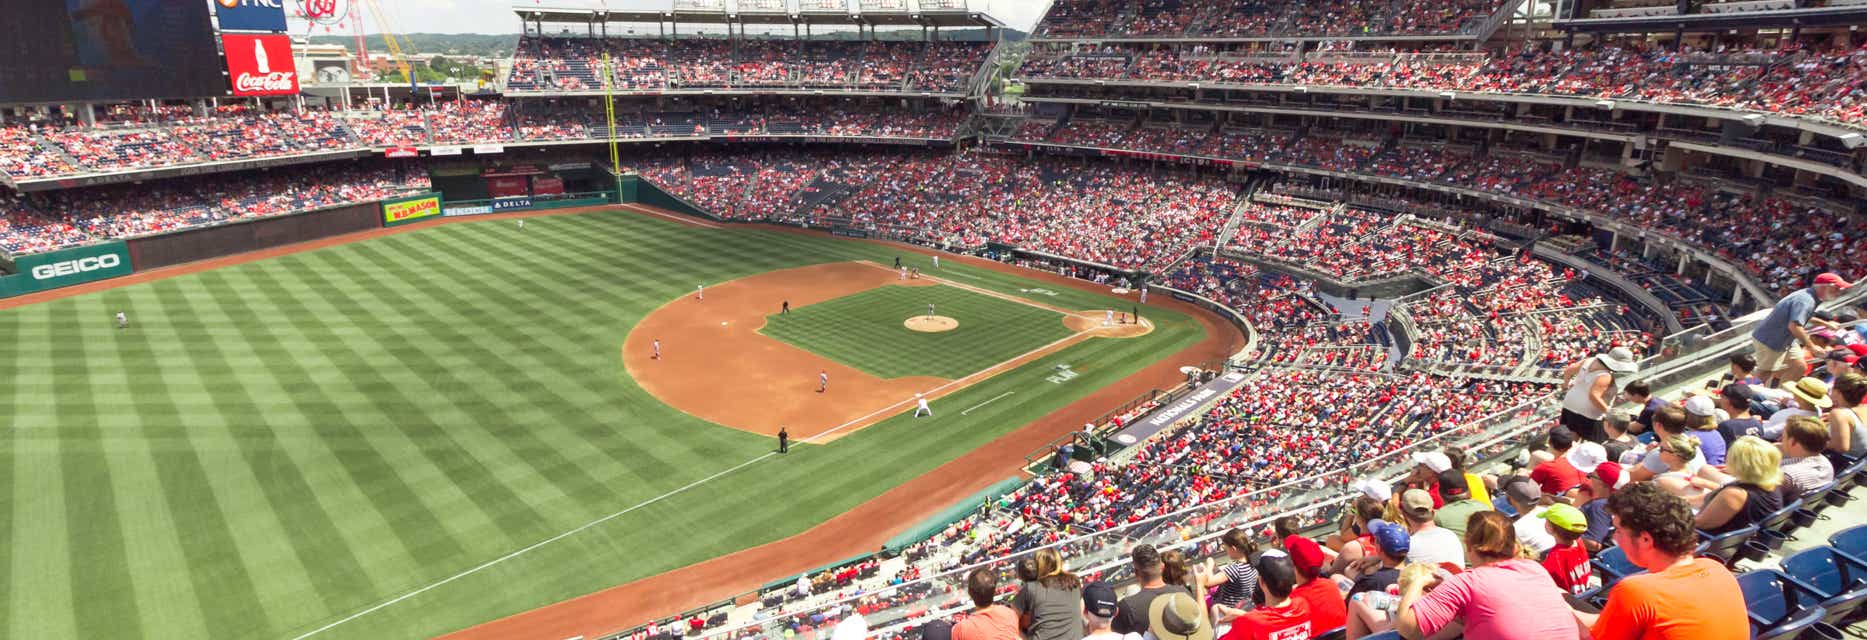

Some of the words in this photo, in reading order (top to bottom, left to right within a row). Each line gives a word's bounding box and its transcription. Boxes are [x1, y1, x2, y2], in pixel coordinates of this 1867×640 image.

[236, 72, 294, 91] Coca-Cola
[503, 200, 531, 208] DELTA
[32, 253, 120, 280] GEICO
[1149, 399, 1197, 426] NATIONALS
